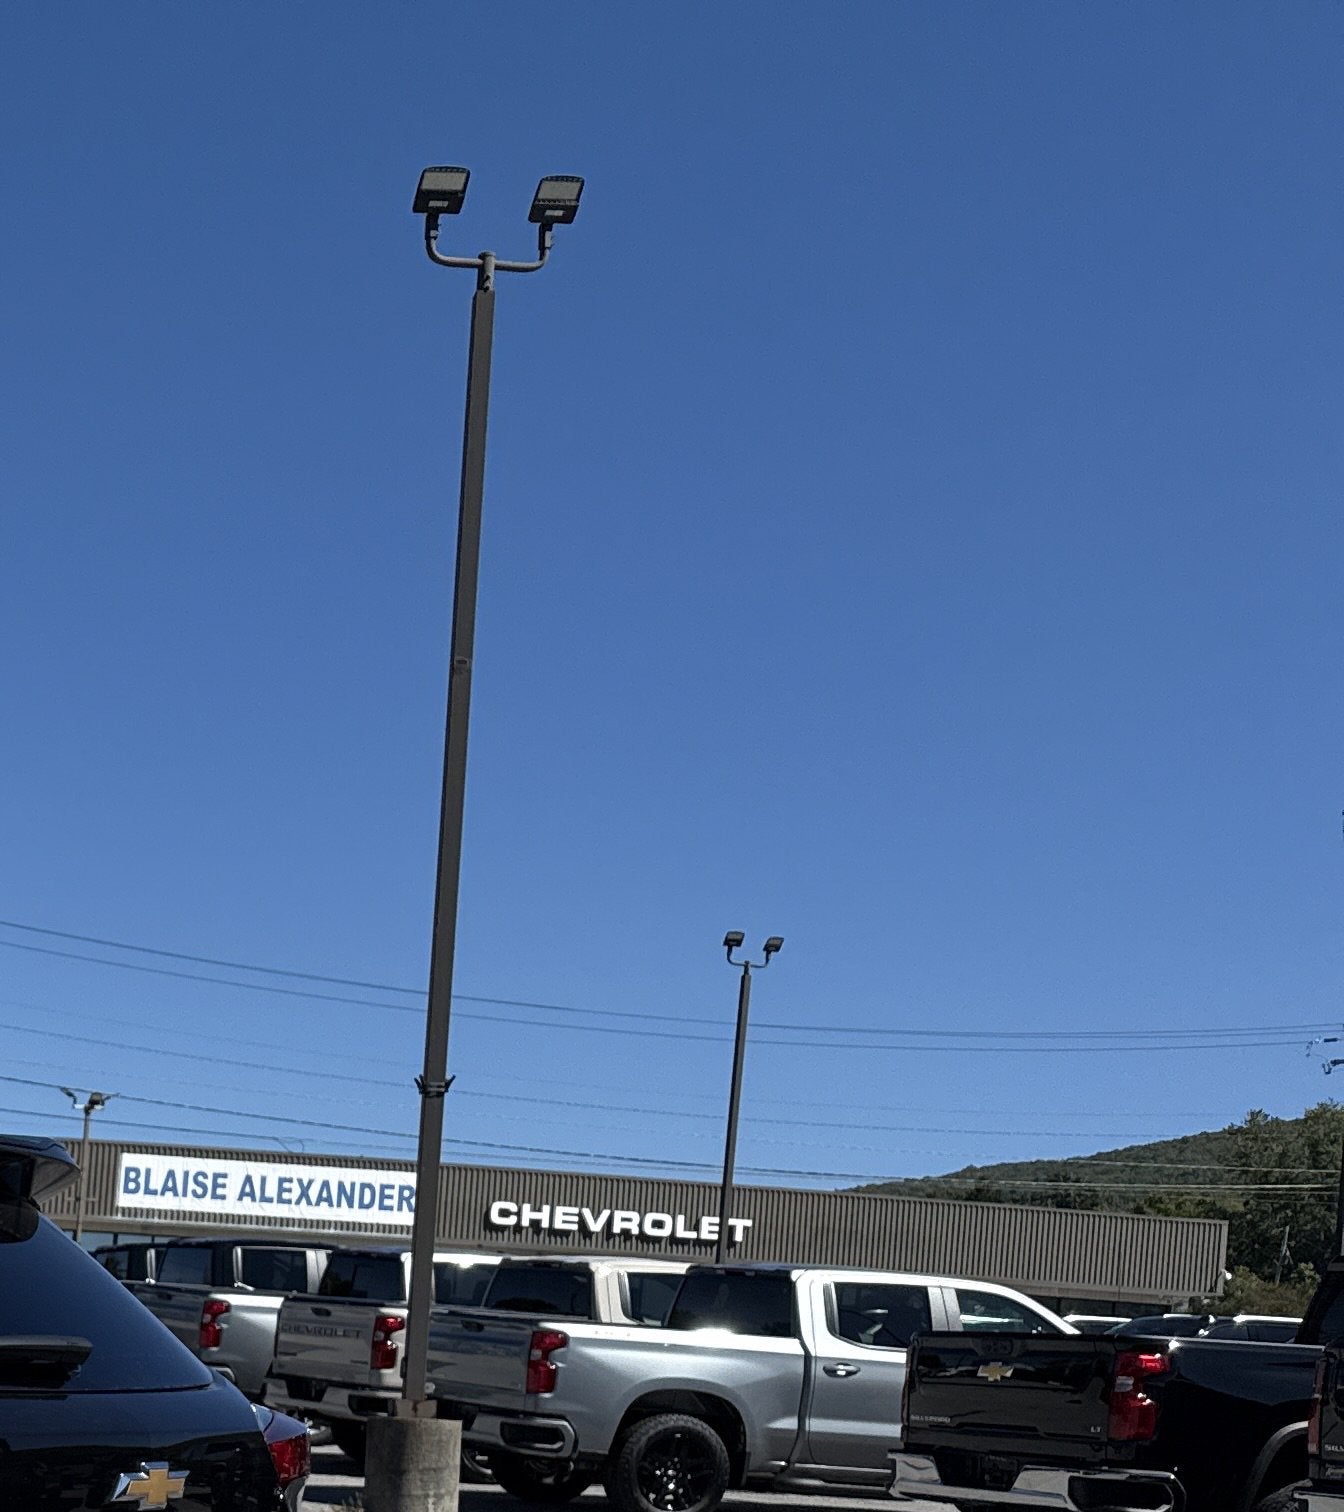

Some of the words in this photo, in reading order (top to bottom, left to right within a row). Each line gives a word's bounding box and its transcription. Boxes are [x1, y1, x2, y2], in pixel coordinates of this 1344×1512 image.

[122, 1166, 228, 1200] BLAISE
[237, 1174, 416, 1213] ALEXANDER
[490, 1200, 753, 1242] CHEVROLET
[280, 1323, 363, 1339] CHEVROLET
